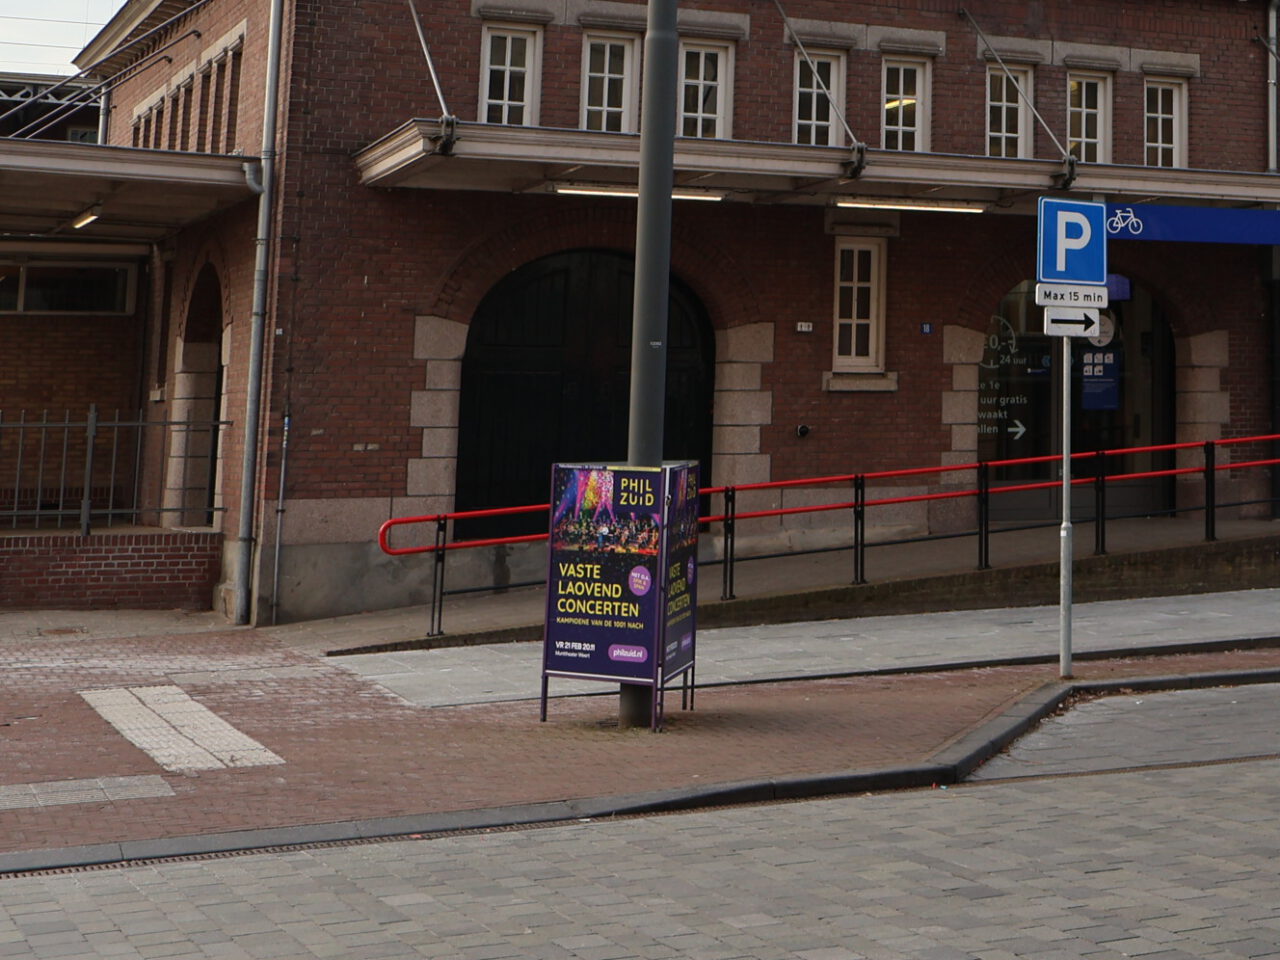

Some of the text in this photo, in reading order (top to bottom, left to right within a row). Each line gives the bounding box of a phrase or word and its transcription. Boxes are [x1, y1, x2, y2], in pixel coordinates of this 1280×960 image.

[1056, 211, 1091, 271] P
[1043, 290, 1103, 302] Max 15 min
[999, 355, 1011, 365] 24
[999, 394, 1028, 407] gratis
[978, 409, 1008, 420] waakt
[621, 478, 653, 494] PHIL
[559, 562, 602, 579] VASTE
[558, 580, 623, 598] LAOVEND
[557, 598, 639, 618] CONCERTEN
[591, 619, 603, 627] VAN
[627, 622, 644, 630] NACH
[555, 640, 564, 649] VR
[564, 641, 571, 649] 21
[571, 642, 582, 650] FEB
